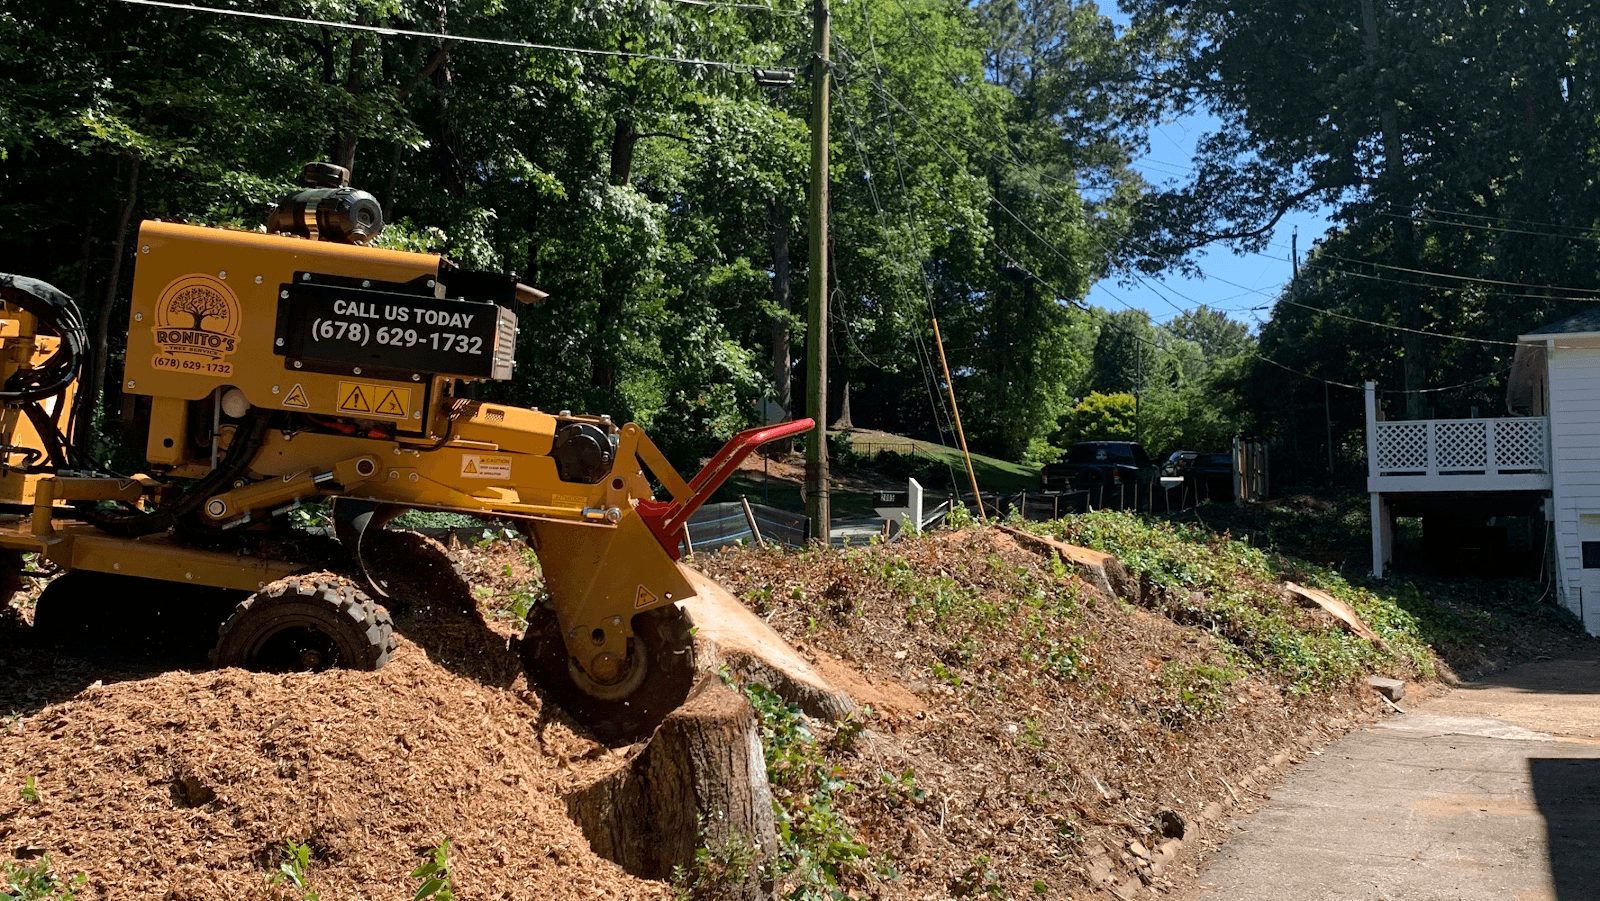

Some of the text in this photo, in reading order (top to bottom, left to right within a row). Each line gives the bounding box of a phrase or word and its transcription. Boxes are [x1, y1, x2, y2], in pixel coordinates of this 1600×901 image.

[333, 300, 474, 329] CALL US TODAY
[156, 330, 235, 352] RONITO'S
[312, 317, 483, 355] (678) 629-1732
[189, 347, 219, 355] SERVICE
[154, 356, 231, 374] (678) 629-1732
